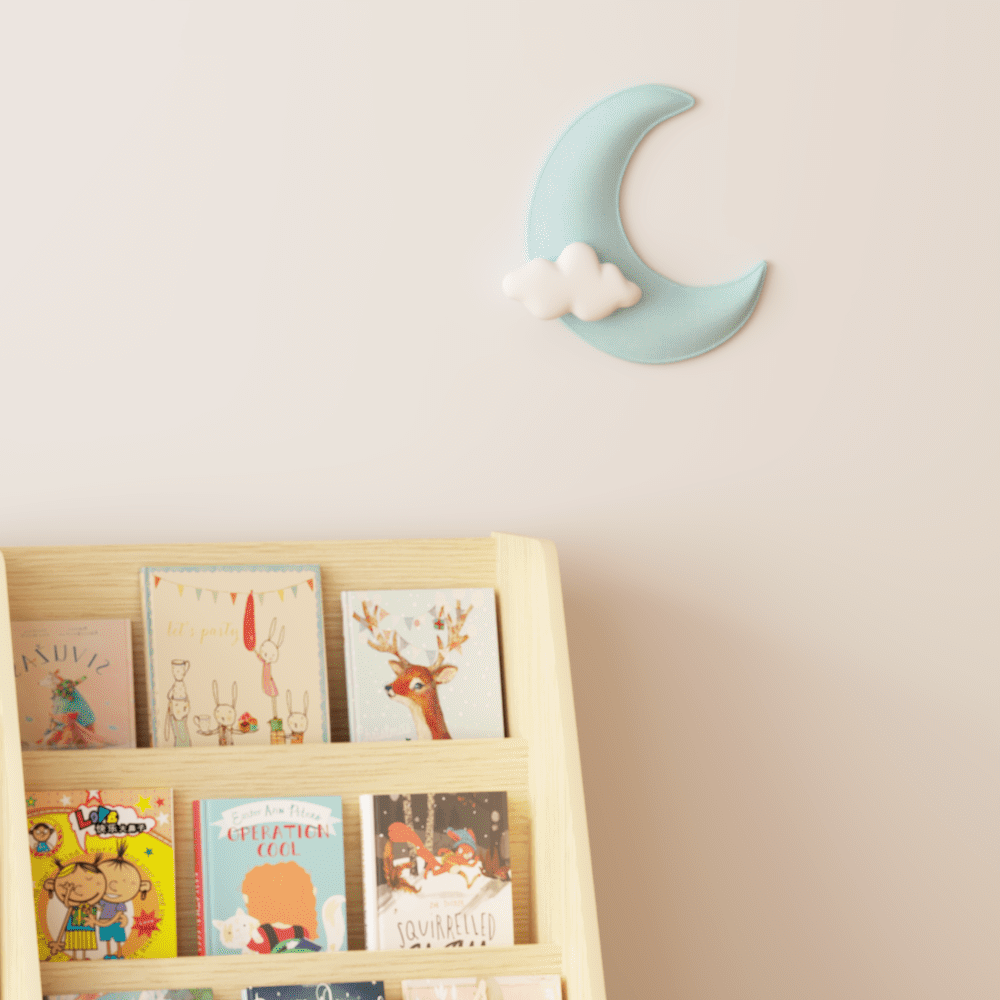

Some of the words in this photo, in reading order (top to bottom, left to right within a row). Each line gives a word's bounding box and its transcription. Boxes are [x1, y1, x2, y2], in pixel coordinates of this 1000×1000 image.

[199, 621, 241, 646] party
[227, 823, 331, 842] OPERATION
[257, 841, 301, 858] COOL
[397, 911, 496, 949] SQUIRRELLED
